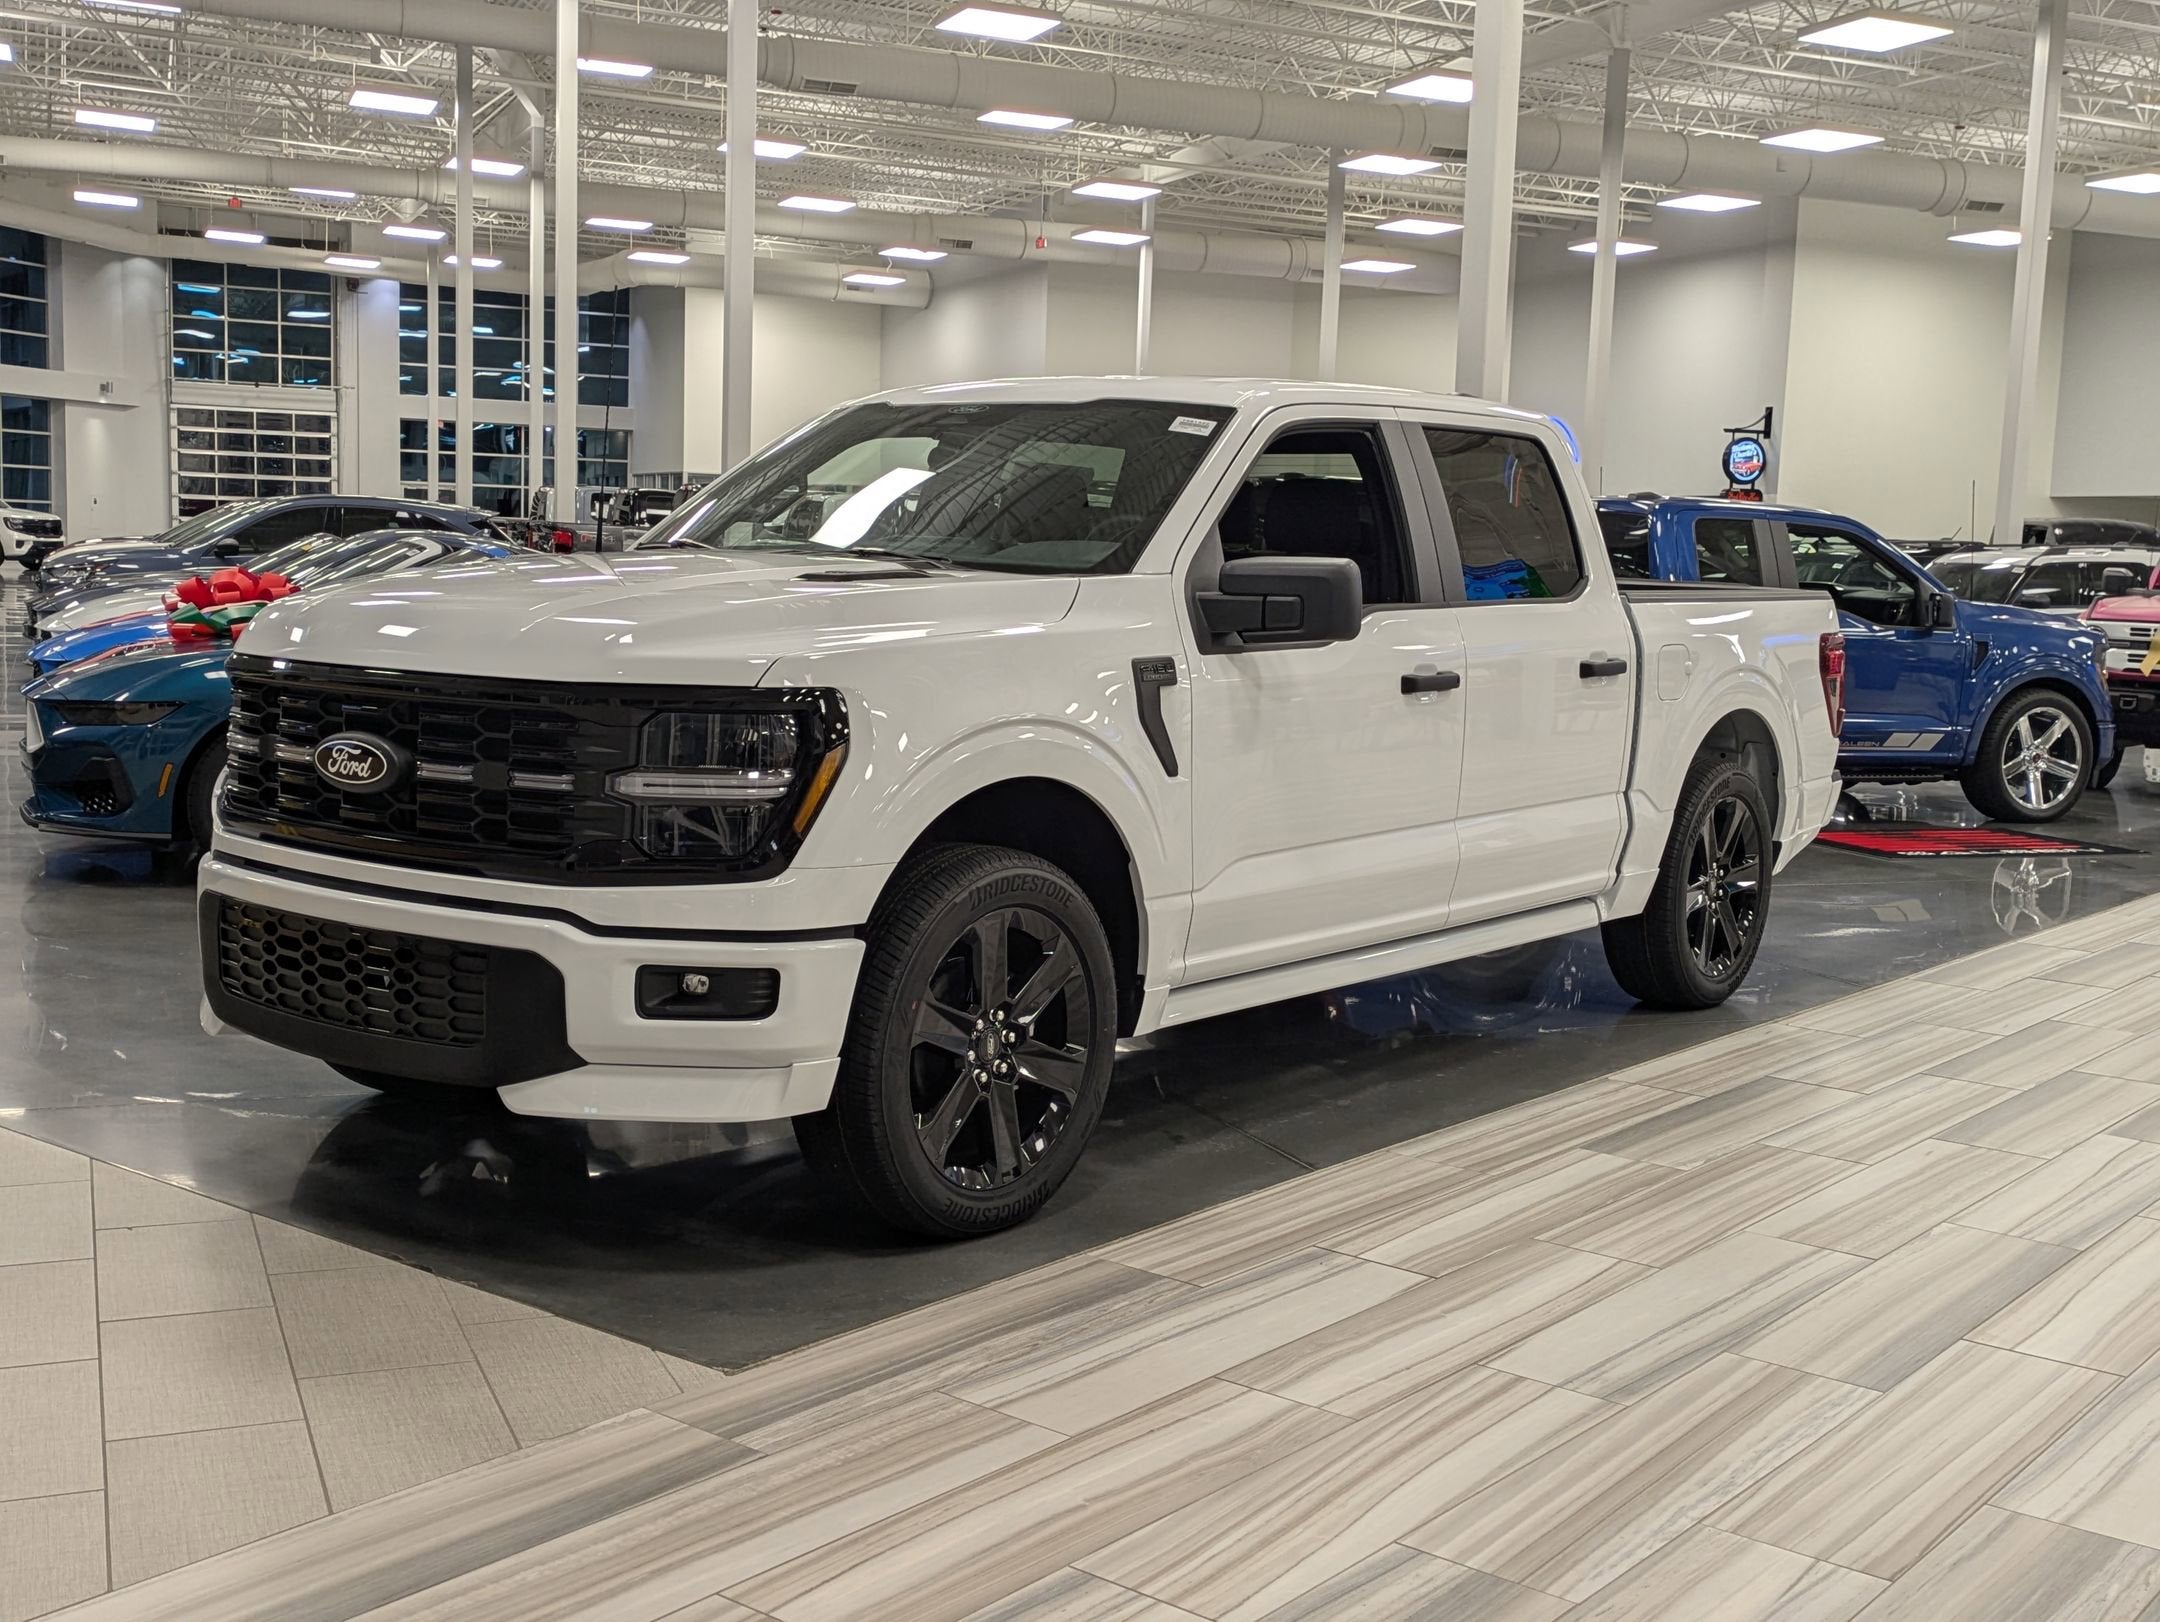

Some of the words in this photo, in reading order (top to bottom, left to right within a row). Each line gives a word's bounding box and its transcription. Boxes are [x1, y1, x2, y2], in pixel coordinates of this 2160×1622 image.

[327, 745, 372, 778] Ford
[968, 873, 1075, 911] BRIDGESTONE
[941, 1178, 1051, 1223] BRIDGESTONE
